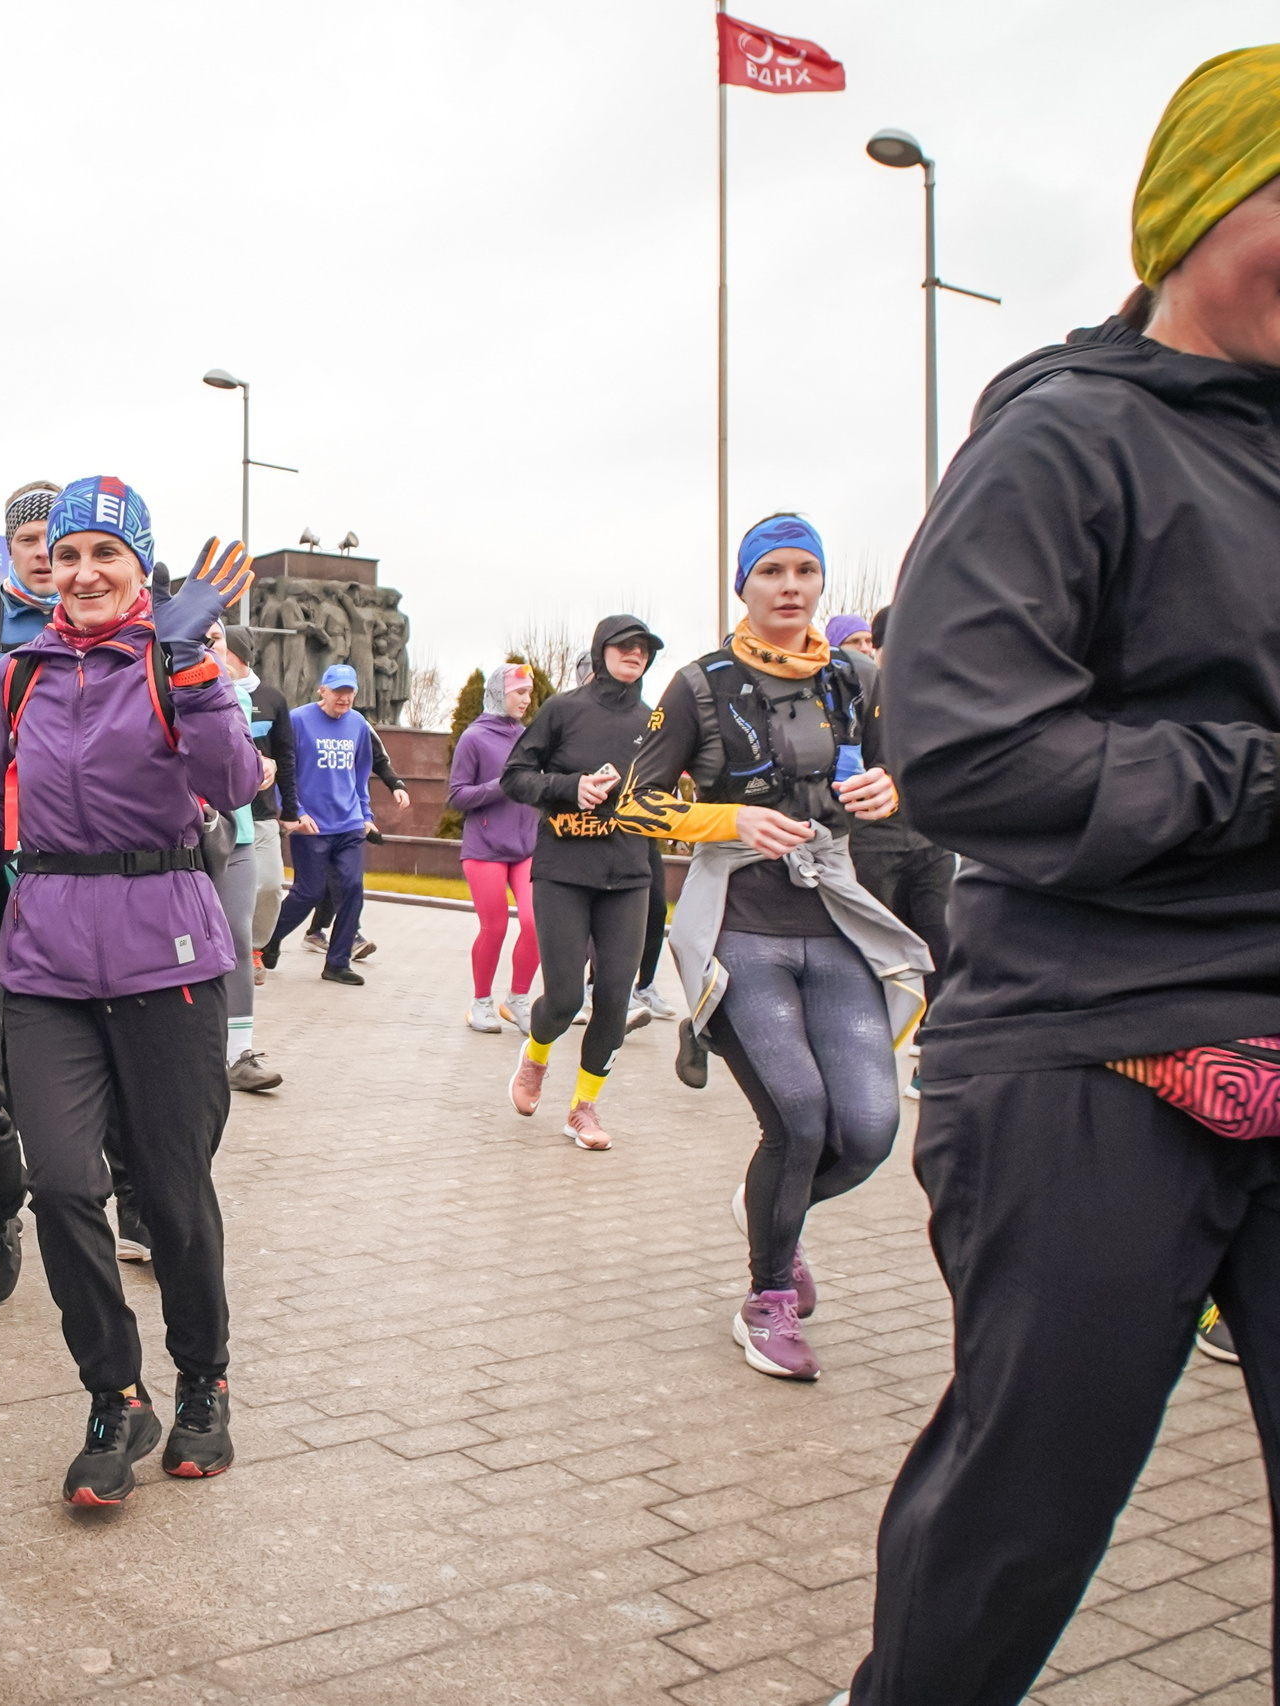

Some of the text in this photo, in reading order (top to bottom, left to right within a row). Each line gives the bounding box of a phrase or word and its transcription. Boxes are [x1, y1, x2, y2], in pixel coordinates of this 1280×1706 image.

[746, 60, 812, 87] ВДНХ
[316, 738, 354, 751] МОСКВА
[317, 750, 354, 770] 2030
